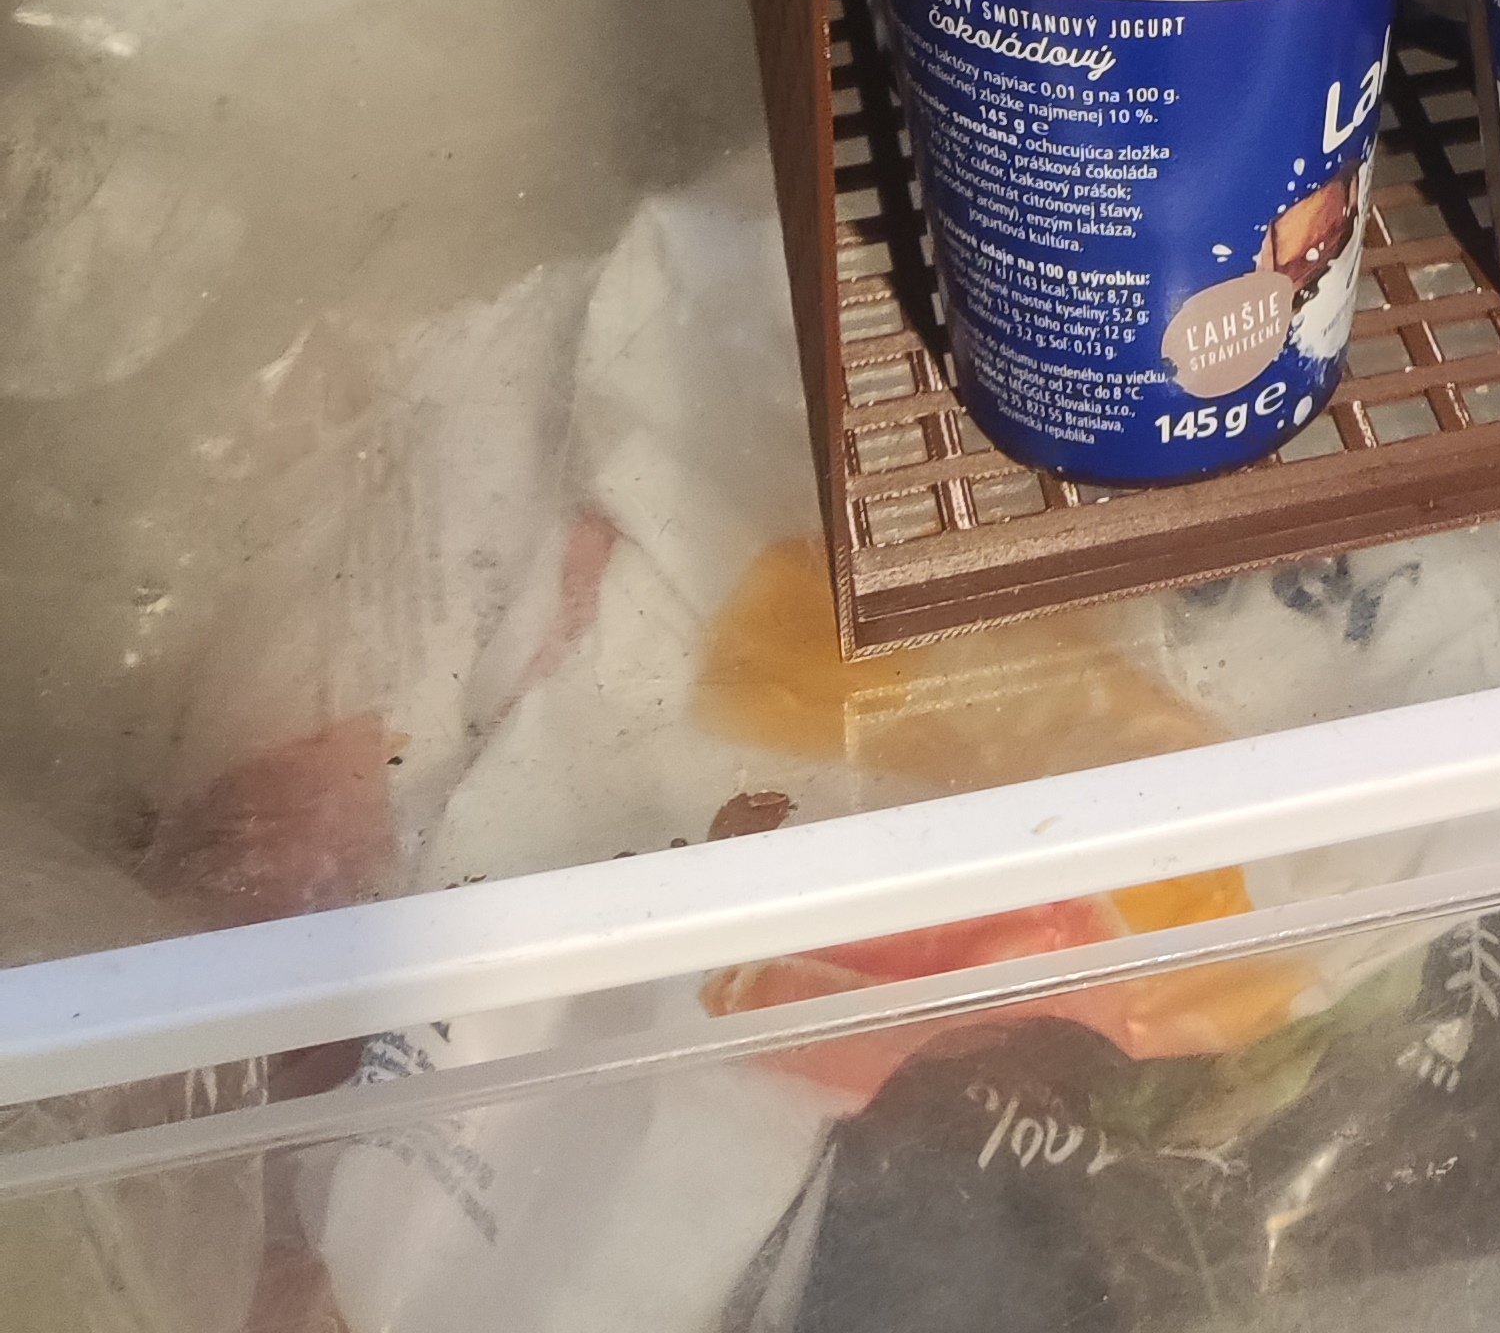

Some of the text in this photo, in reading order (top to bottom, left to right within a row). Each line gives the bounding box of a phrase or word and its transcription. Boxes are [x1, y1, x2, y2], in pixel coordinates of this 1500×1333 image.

[981, 0, 1187, 40] SMOTANOVÝ JOGURT
[927, 3, 1117, 81] čokoládový
[933, 43, 981, 81] laktózy
[982, 69, 1039, 97] najviac
[1039, 80, 1076, 101] 0,01
[1081, 88, 1095, 106] g
[1098, 89, 1120, 103] na
[1125, 86, 1159, 104] 100
[1162, 89, 1181, 106] g.
[978, 84, 1026, 112] zložke
[1028, 102, 1104, 128] najmenej
[1108, 108, 1131, 124] 10
[1134, 108, 1159, 125] %.
[978, 104, 1009, 127] 145
[1013, 118, 1026, 135] g
[952, 111, 1023, 149] smotana,
[1024, 138, 1114, 162] ochucujúca
[1117, 143, 1171, 162] zložka
[970, 153, 1007, 182] cukor,
[1008, 167, 1070, 198] kakaový
[1073, 181, 1134, 201] prášok;
[974, 141, 1013, 165] voda,
[1013, 154, 1082, 179] prášková
[1085, 163, 1158, 180] čokoláda
[975, 190, 1137, 240] arómy), enzým laktáza,
[1021, 191, 1096, 219] citrónovej
[1099, 201, 1144, 221] šťavy,
[979, 239, 1015, 267] údaje
[1016, 256, 1035, 274] na
[1037, 261, 1064, 280] 100
[1066, 270, 1078, 285] g
[1080, 269, 1151, 288] výrobku:
[1010, 286, 1053, 313] mastné
[1054, 298, 1111, 325] kyseliny:
[1111, 307, 1133, 325] 5,2
[1015, 271, 1039, 291] 143
[1039, 277, 1070, 301] kcal;
[1071, 284, 1105, 305] Tuky:
[1106, 288, 1129, 305] 8,7
[996, 296, 1011, 315] 13
[1033, 310, 1062, 333] toho
[1062, 322, 1102, 345] cukry:
[1103, 324, 1120, 341] 12
[1015, 322, 1034, 343] 3,2
[1073, 338, 1102, 358] 0,13
[1186, 290, 1280, 352] ĽAHŠIE
[1189, 317, 1282, 372] STRÁVITEĽNÉ
[1039, 360, 1104, 385] uvedeného
[1105, 370, 1123, 385] na
[1047, 377, 1064, 393] od
[1064, 380, 1074, 395] 2
[1094, 384, 1111, 401] do
[1112, 386, 1123, 401] 8
[1026, 397, 1047, 418] 823
[1064, 412, 1126, 434] Bratislava,
[1053, 391, 1103, 415] Slovakia
[1154, 405, 1219, 445] 145
[1224, 401, 1249, 438] g
[1043, 422, 1096, 446] republika
